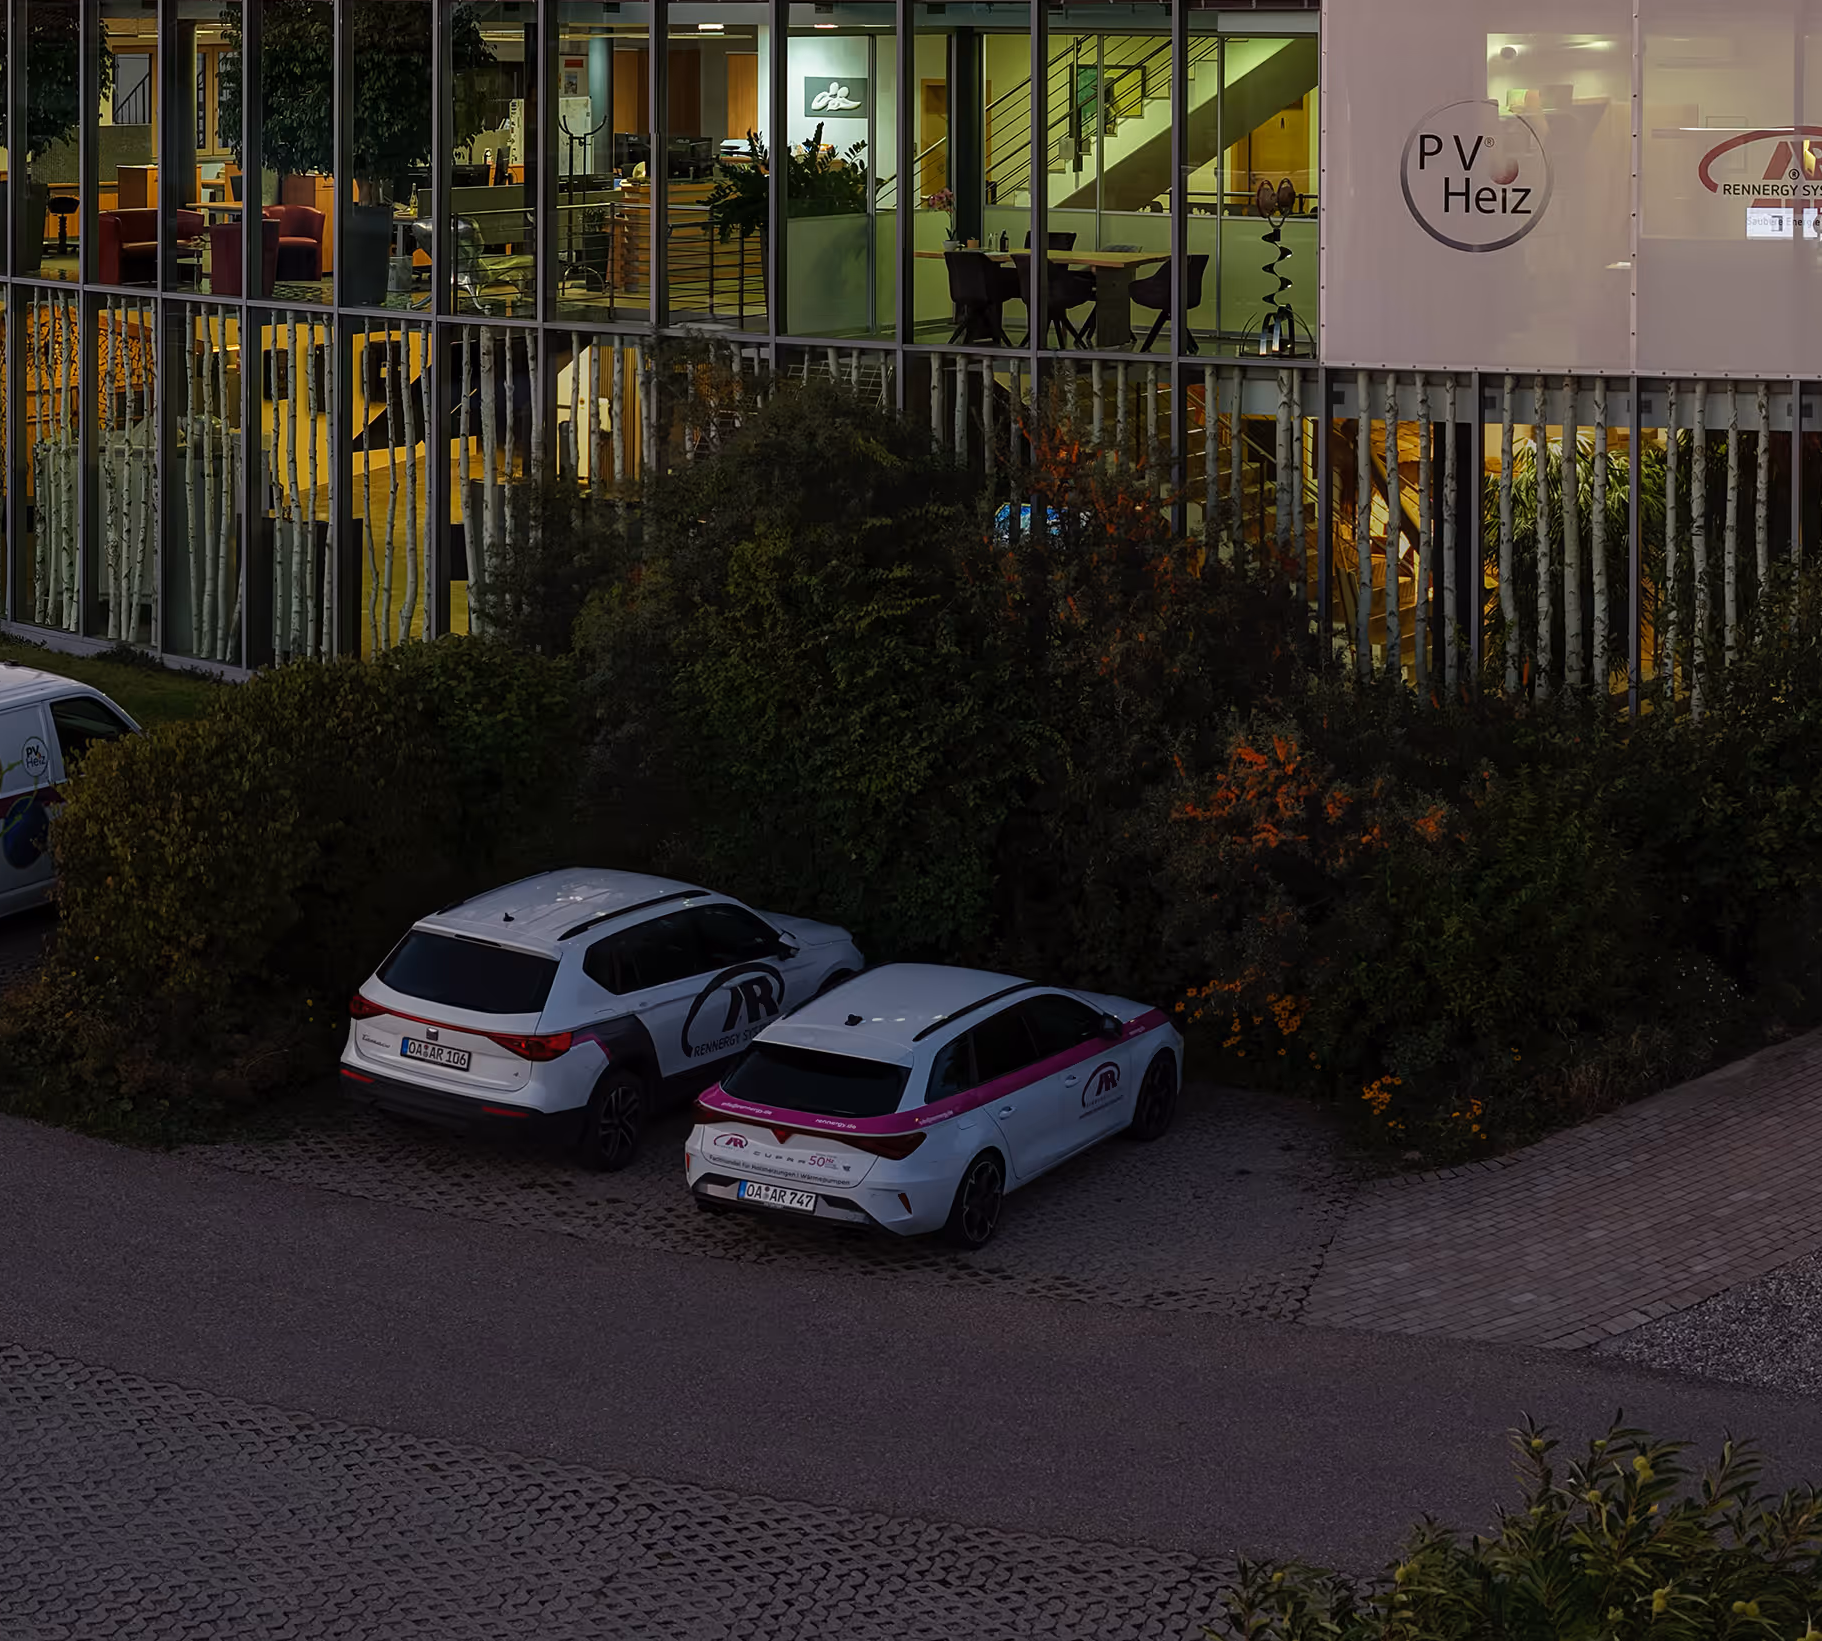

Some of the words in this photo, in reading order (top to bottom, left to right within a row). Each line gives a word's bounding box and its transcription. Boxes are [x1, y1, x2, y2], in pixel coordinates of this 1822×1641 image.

[1444, 177, 1531, 214] Heiz
[1723, 184, 1798, 196] RENNERGY
[26, 745, 39, 758] PV
[408, 1041, 422, 1056] OA
[429, 1047, 442, 1061] AR
[447, 1051, 467, 1066] 106
[694, 1034, 740, 1057] RENNERGY
[746, 1184, 762, 1199] OA
[770, 1189, 786, 1203] AR
[790, 1192, 813, 1208] 747
